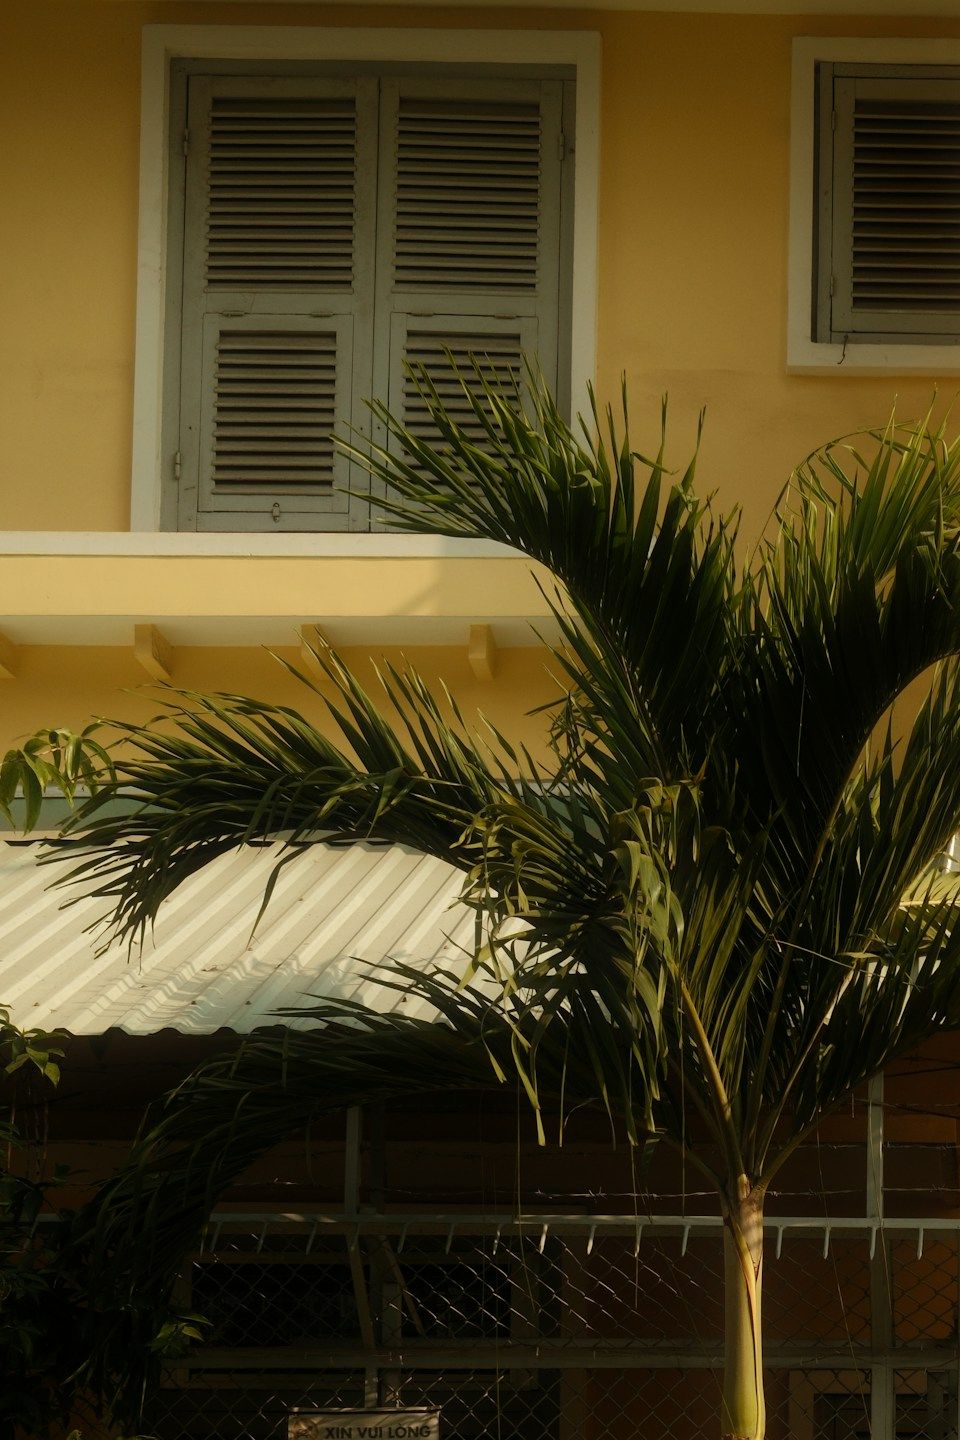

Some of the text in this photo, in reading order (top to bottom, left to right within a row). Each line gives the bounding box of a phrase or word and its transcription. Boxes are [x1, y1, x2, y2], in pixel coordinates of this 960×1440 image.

[325, 1424, 431, 1439] XIN VUI LÒNG
